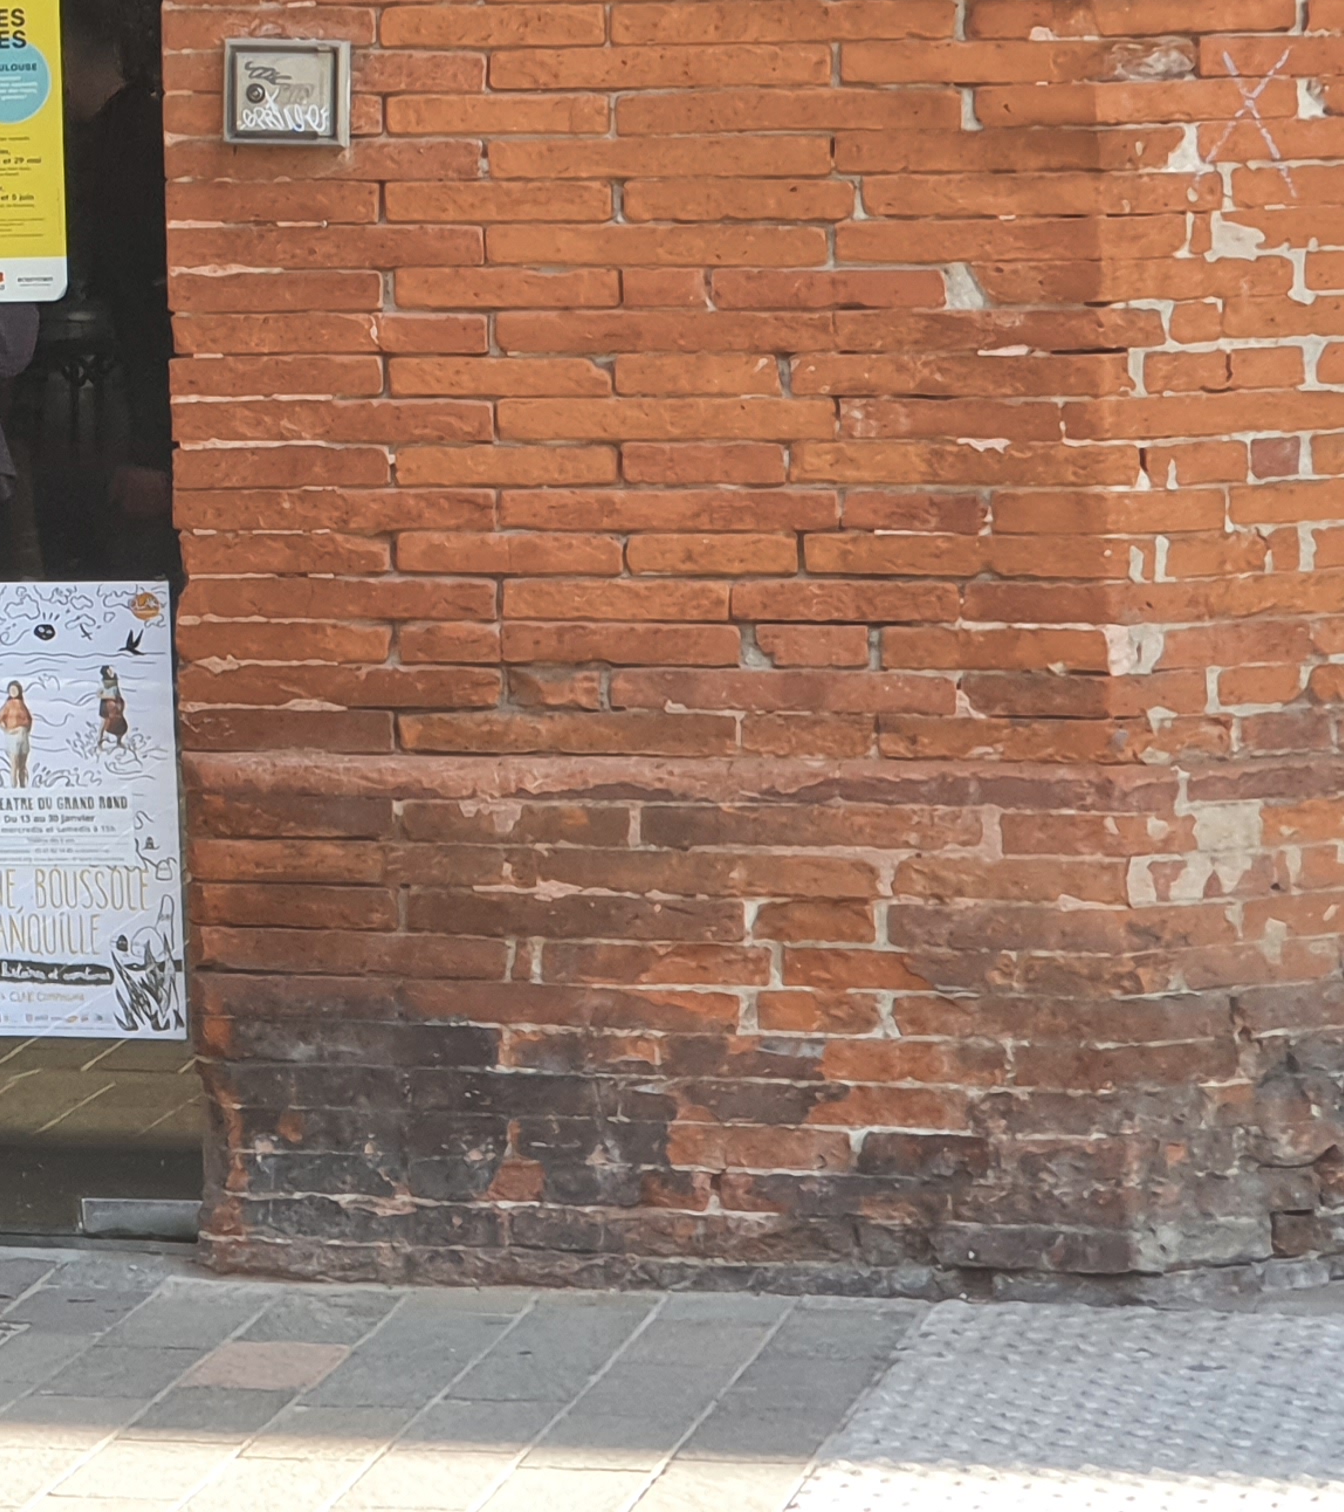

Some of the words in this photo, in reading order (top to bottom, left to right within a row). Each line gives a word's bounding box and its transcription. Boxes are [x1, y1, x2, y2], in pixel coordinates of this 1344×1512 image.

[38, 797, 52, 809] DU
[57, 797, 95, 810] GRAND
[4, 815, 17, 823] Du
[35, 866, 149, 911] BOUSSOLE
